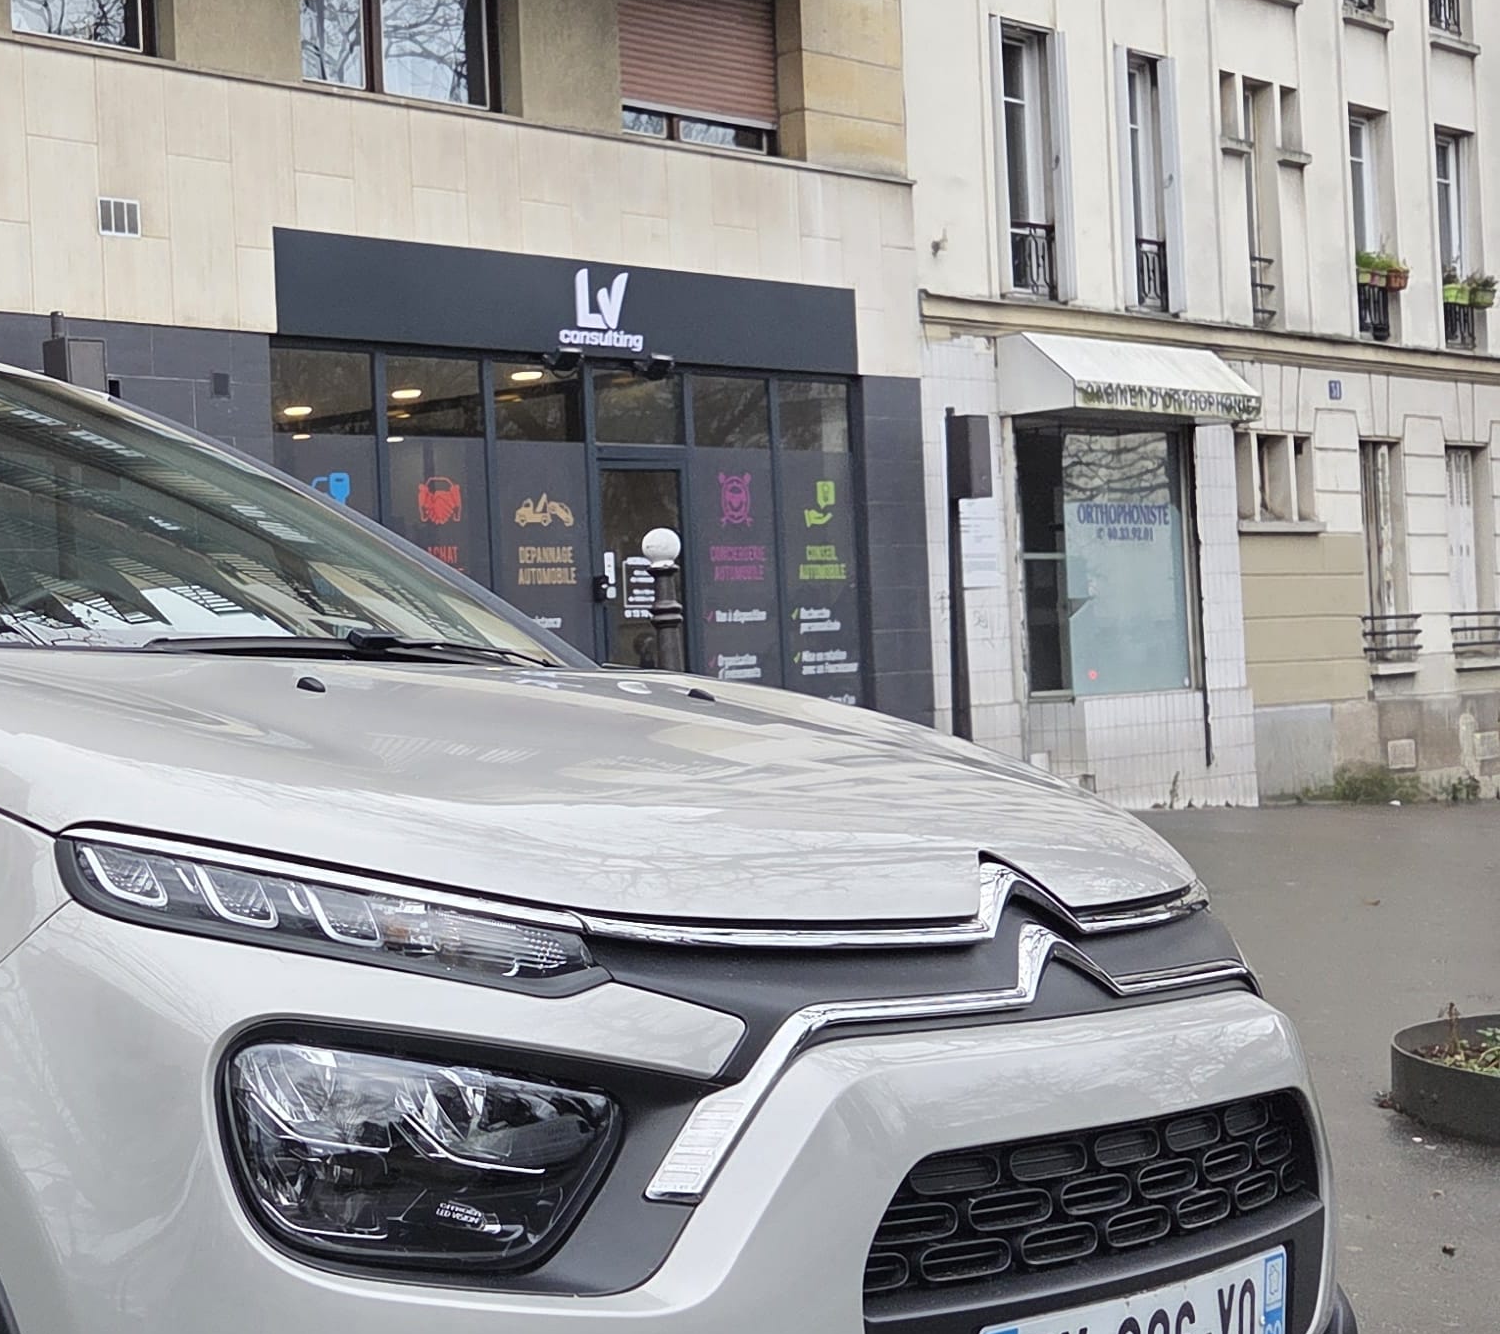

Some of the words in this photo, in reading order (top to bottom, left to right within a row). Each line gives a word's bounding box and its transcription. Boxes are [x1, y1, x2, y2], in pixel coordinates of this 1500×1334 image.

[574, 267, 629, 330] LV
[558, 329, 644, 352] consulting
[1084, 382, 1145, 407] CABINET
[1077, 503, 1169, 526] ORTHOPHONISTE
[517, 567, 577, 585] AUTOMOBILE
[435, 1208, 451, 1218] LED
